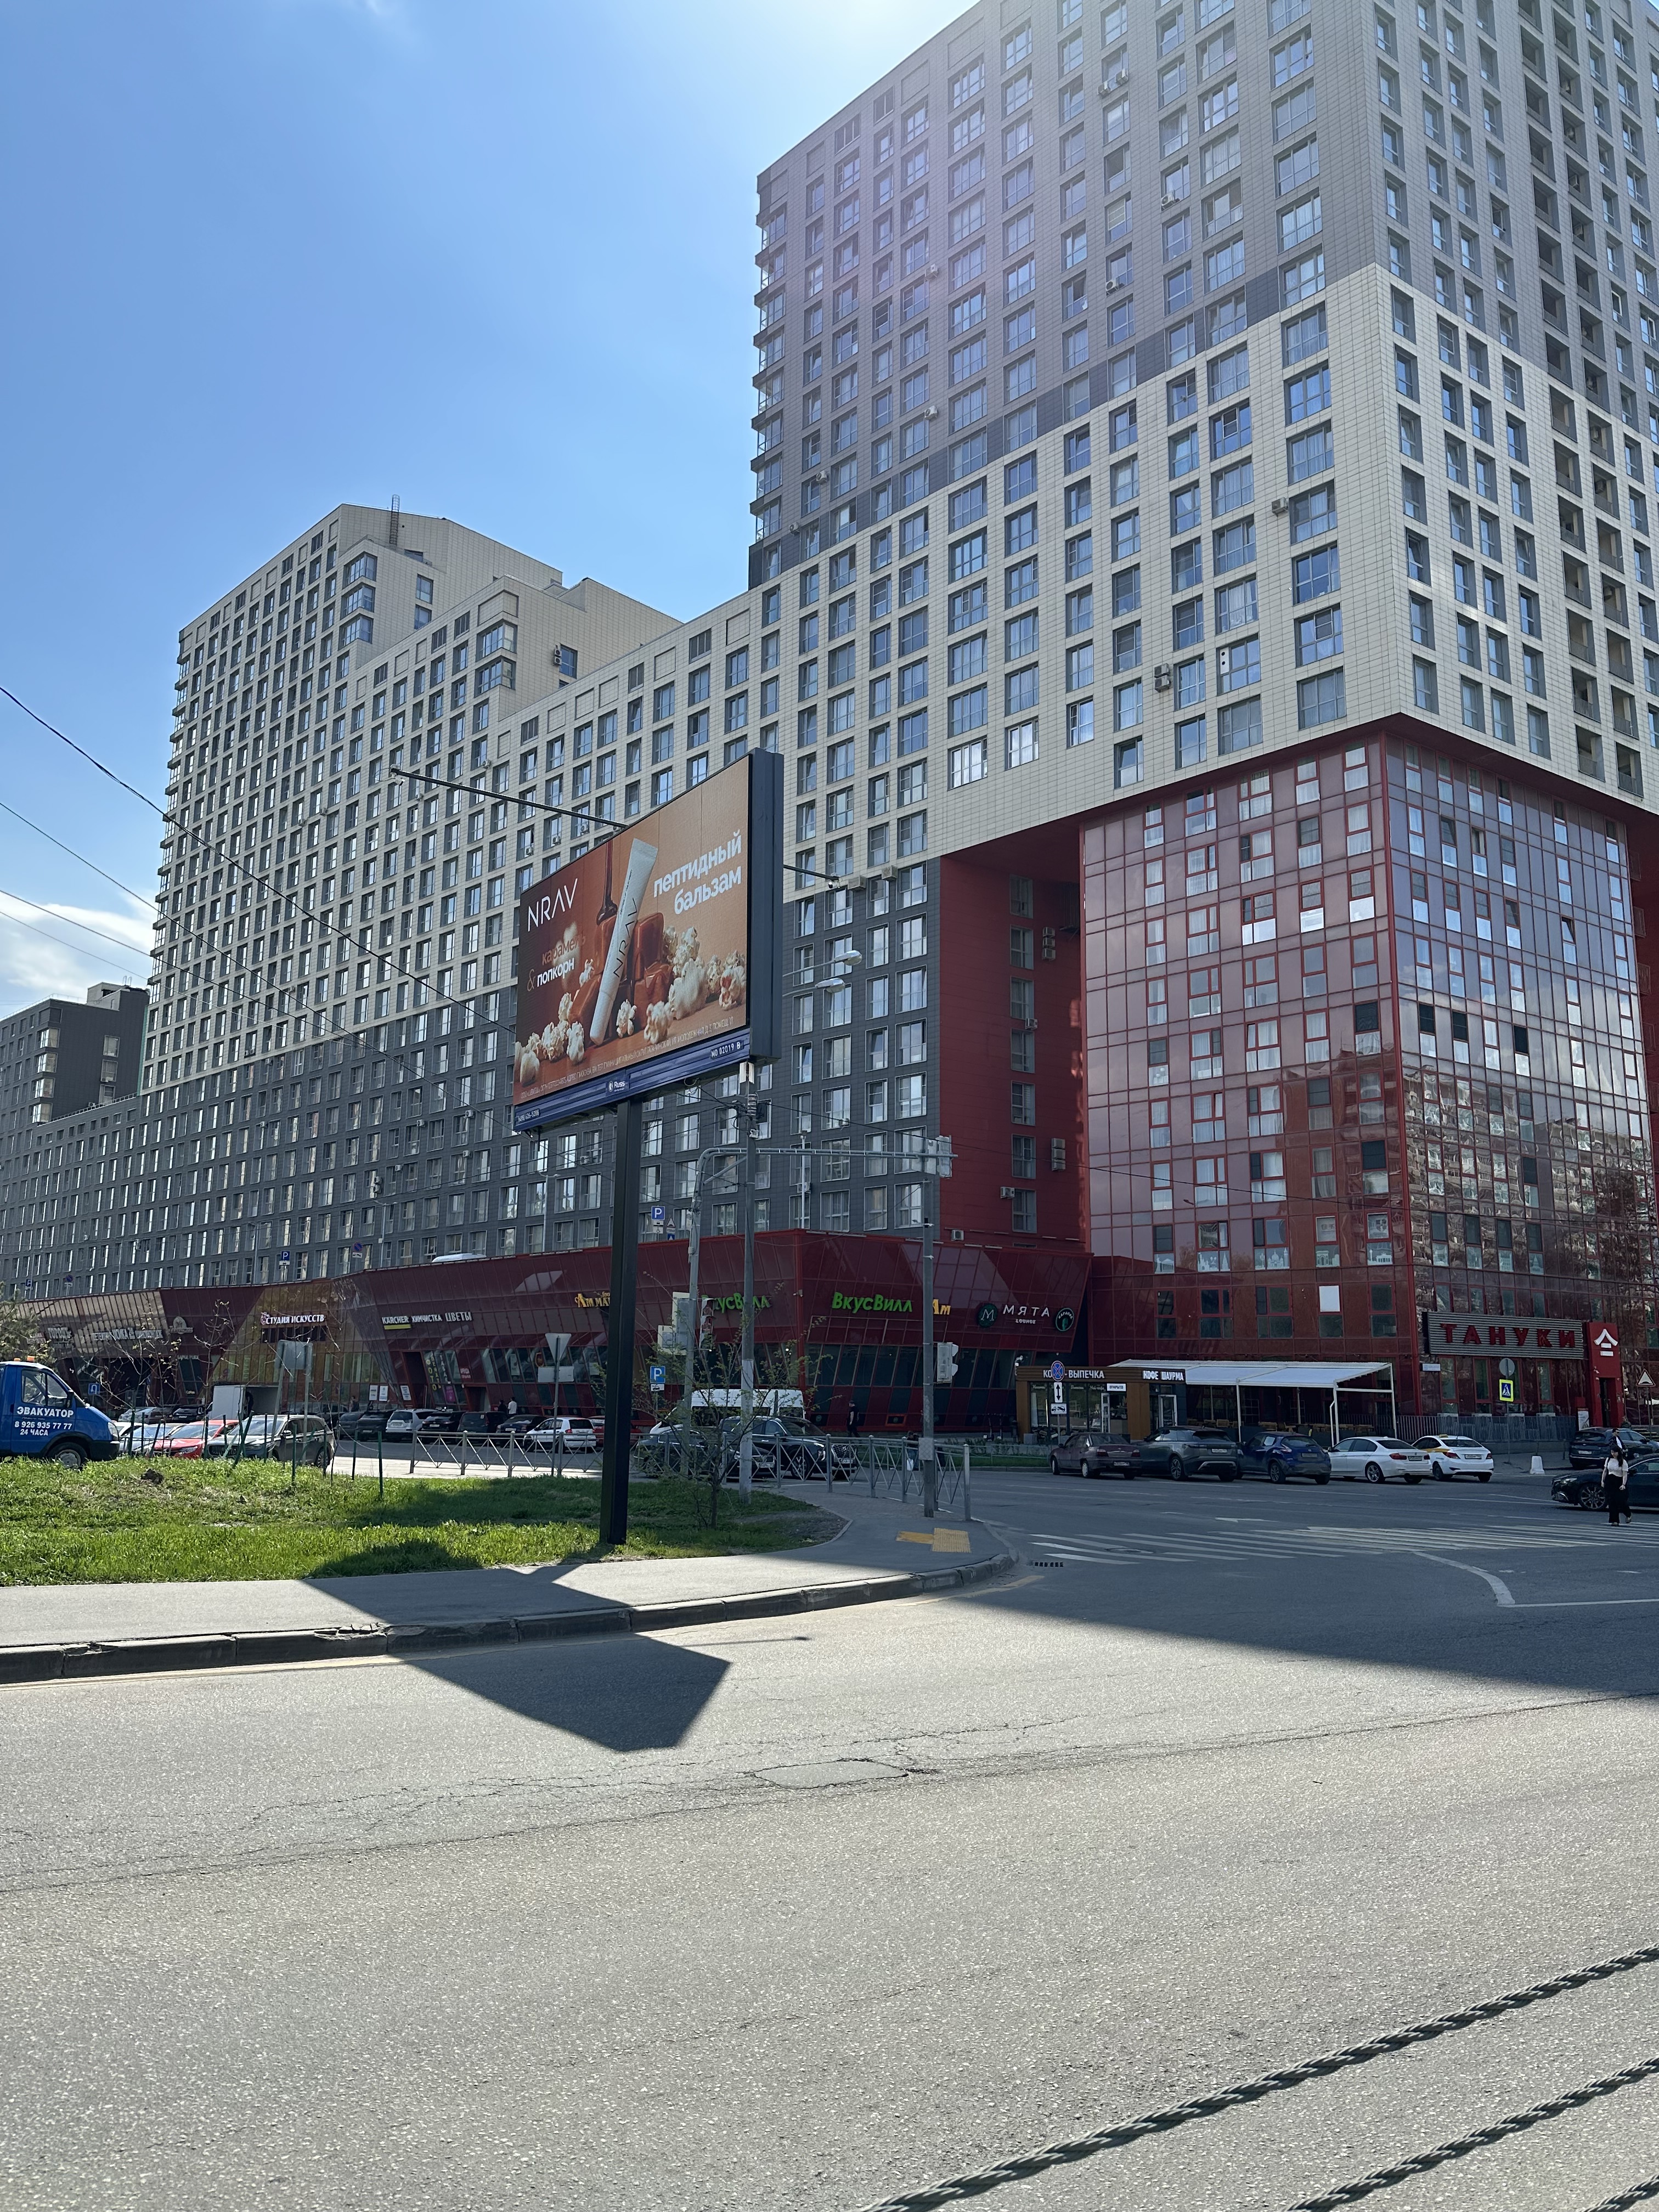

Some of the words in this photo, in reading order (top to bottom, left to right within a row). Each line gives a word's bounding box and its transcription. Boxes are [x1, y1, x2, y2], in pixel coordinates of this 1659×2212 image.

[653, 829, 742, 898] пептидный
[674, 866, 741, 915] бальзам
[528, 878, 578, 932] NRAV
[542, 933, 586, 966] карамель
[537, 957, 574, 988] попкорн
[719, 1043, 734, 1055] 02019
[614, 1081, 625, 1089] Russ
[654, 1207, 662, 1218] P
[283, 1251, 289, 1260] P
[832, 1291, 913, 1314] ВкусВилл
[444, 1311, 472, 1322] ЦВЕТЫ
[1003, 1304, 1050, 1317] МЯТА
[266, 1316, 290, 1324] СТУДИЯ
[291, 1314, 325, 1323] ИСКУССТВ
[411, 1314, 442, 1323] ХИМЧИСТКА
[1440, 1323, 1576, 1348] ТАНУКИ
[654, 1368, 662, 1381] P
[1068, 1369, 1105, 1379] ВЫПЕЧКА
[1142, 1370, 1159, 1380] КОФЕ
[1160, 1371, 1184, 1381] ШАУРМА
[16, 1406, 74, 1418] ЭВАКУАТОР
